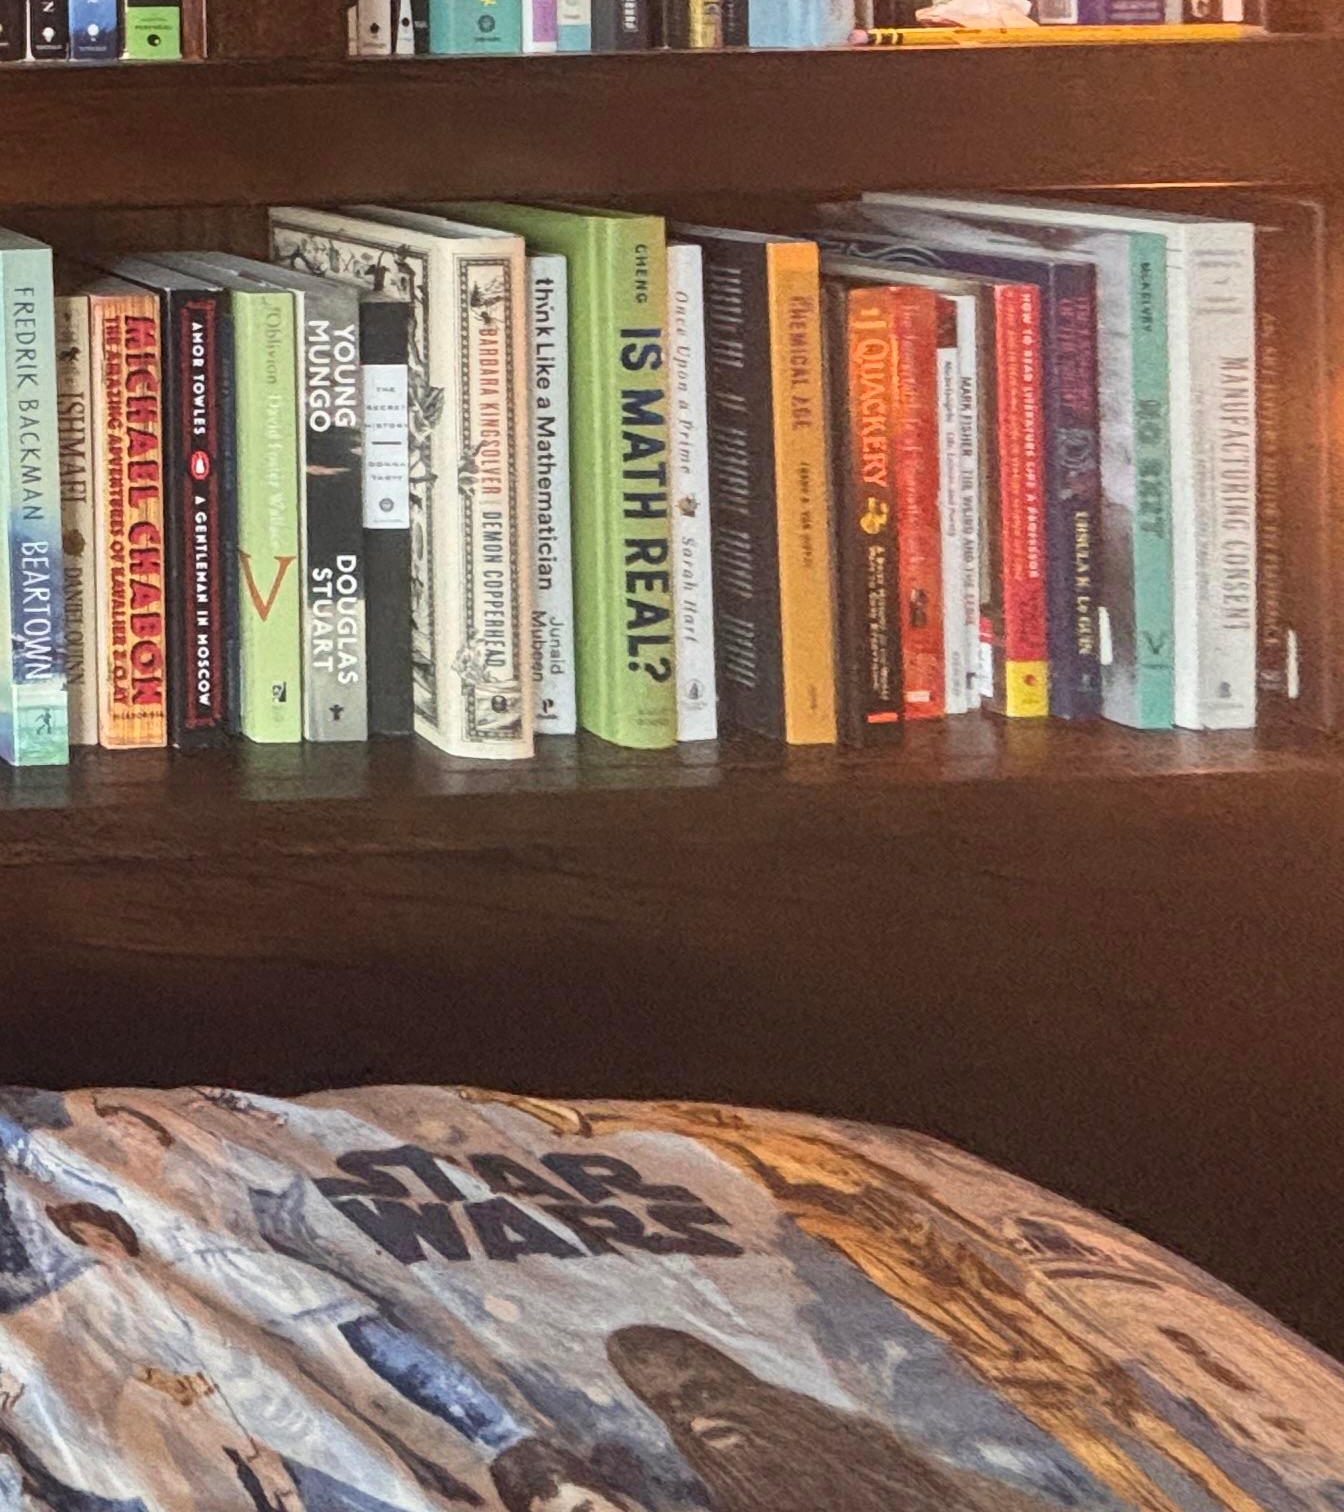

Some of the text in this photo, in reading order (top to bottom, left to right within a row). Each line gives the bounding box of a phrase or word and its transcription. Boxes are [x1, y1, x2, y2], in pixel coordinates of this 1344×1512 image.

[308, 319, 331, 433] MUNGO
[333, 324, 357, 429] YOUNG
[861, 338, 889, 488] QUACKERY
[14, 287, 52, 681] FREDRIK BACKMAN BEARTOWN
[57, 391, 87, 505] ISHMAEL
[124, 314, 162, 705] MICHAEL CHABON
[619, 327, 672, 684] IS MATH REAL?
[1220, 356, 1251, 631] MANUFACTURING CONSENT
[311, 567, 333, 672] STUART
[336, 554, 359, 686] DOUGLAS
[314, 1142, 704, 1207] STAR
[338, 1196, 746, 1266] WARS
